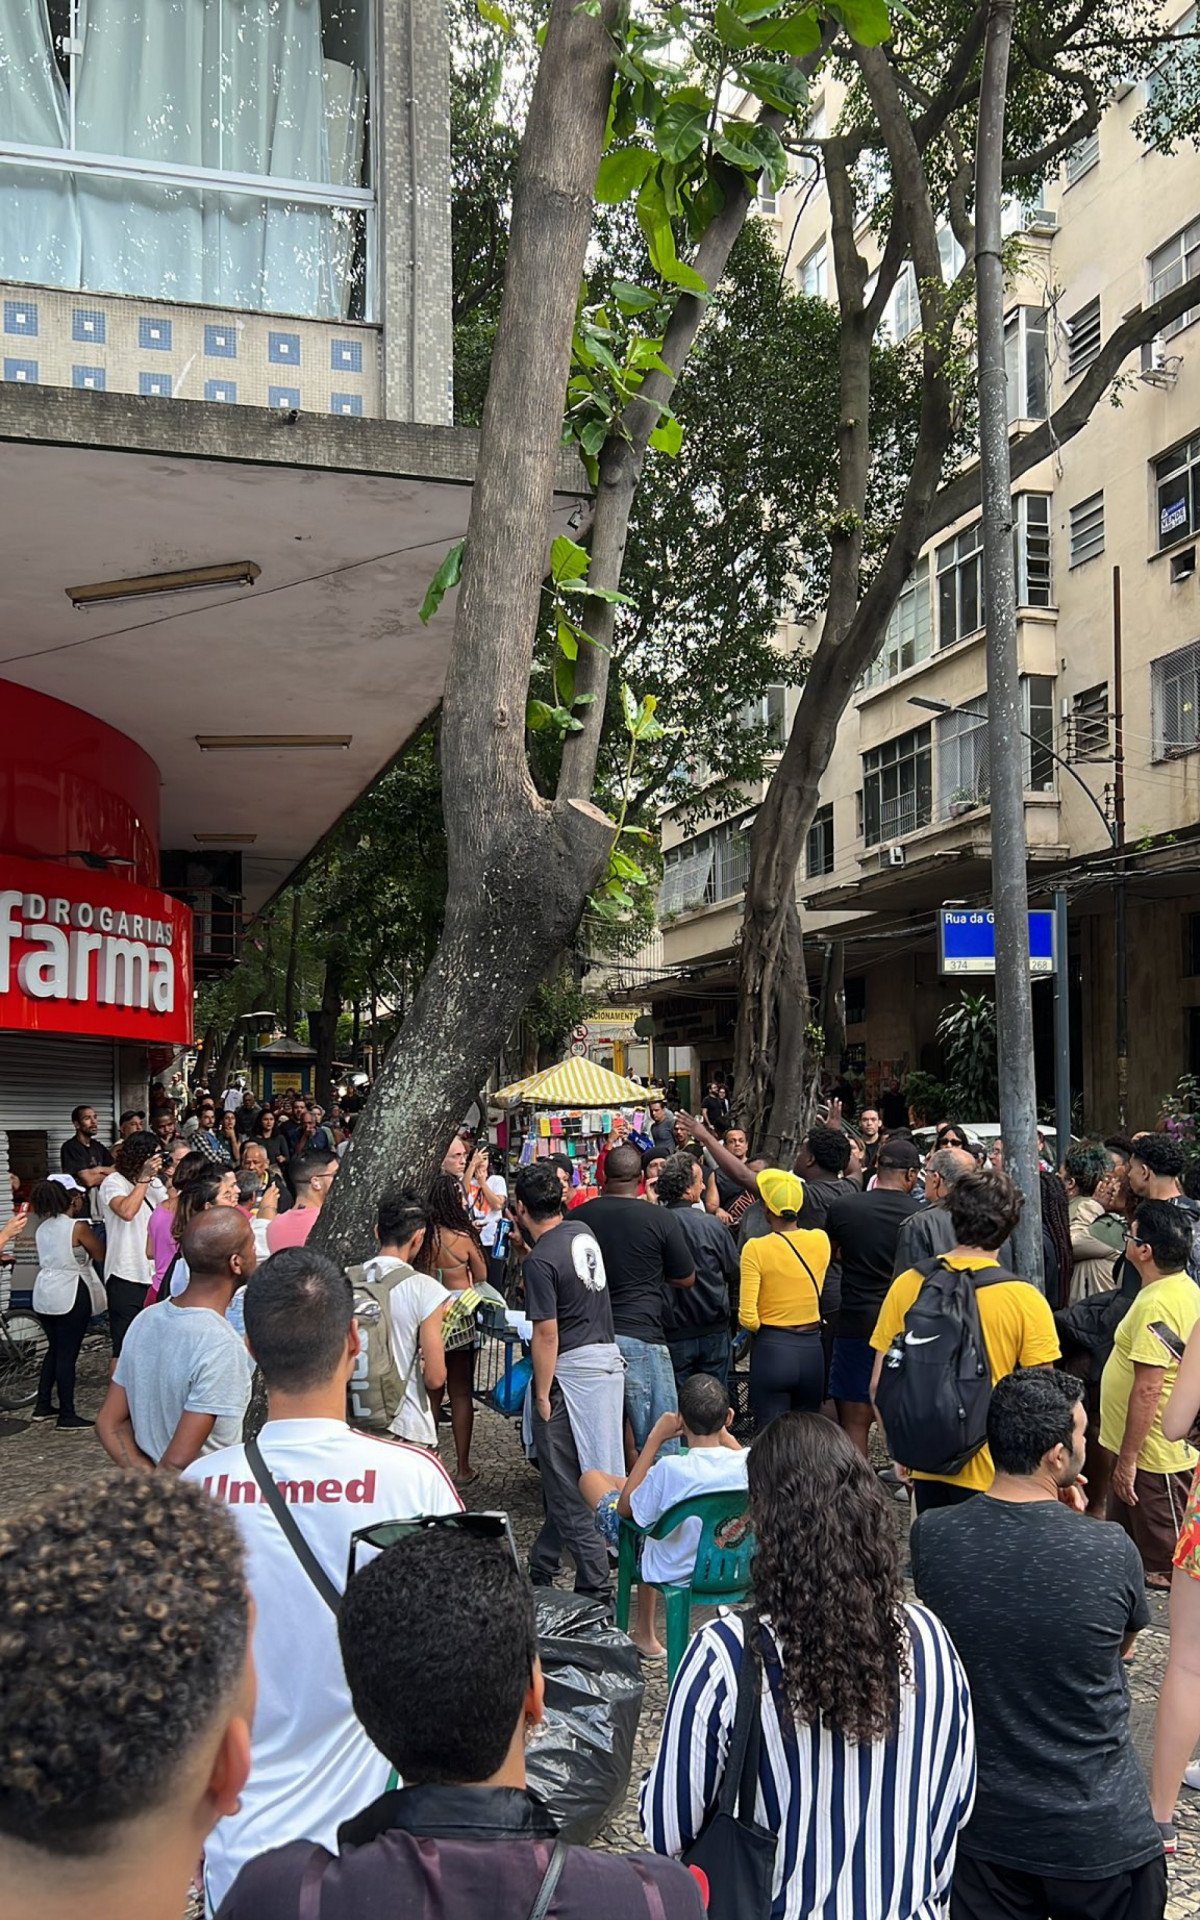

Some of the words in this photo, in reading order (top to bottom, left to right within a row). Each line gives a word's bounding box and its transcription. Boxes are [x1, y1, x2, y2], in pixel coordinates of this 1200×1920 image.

[22, 893, 173, 946] DROGARIAS
[945, 913, 967, 924] Rua
[970, 913, 983, 924] da
[986, 913, 995, 924] G
[0, 890, 174, 1013] farma
[950, 961, 968, 970] 374
[1032, 961, 1048, 969] 268
[203, 1469, 377, 1504] Unmed
